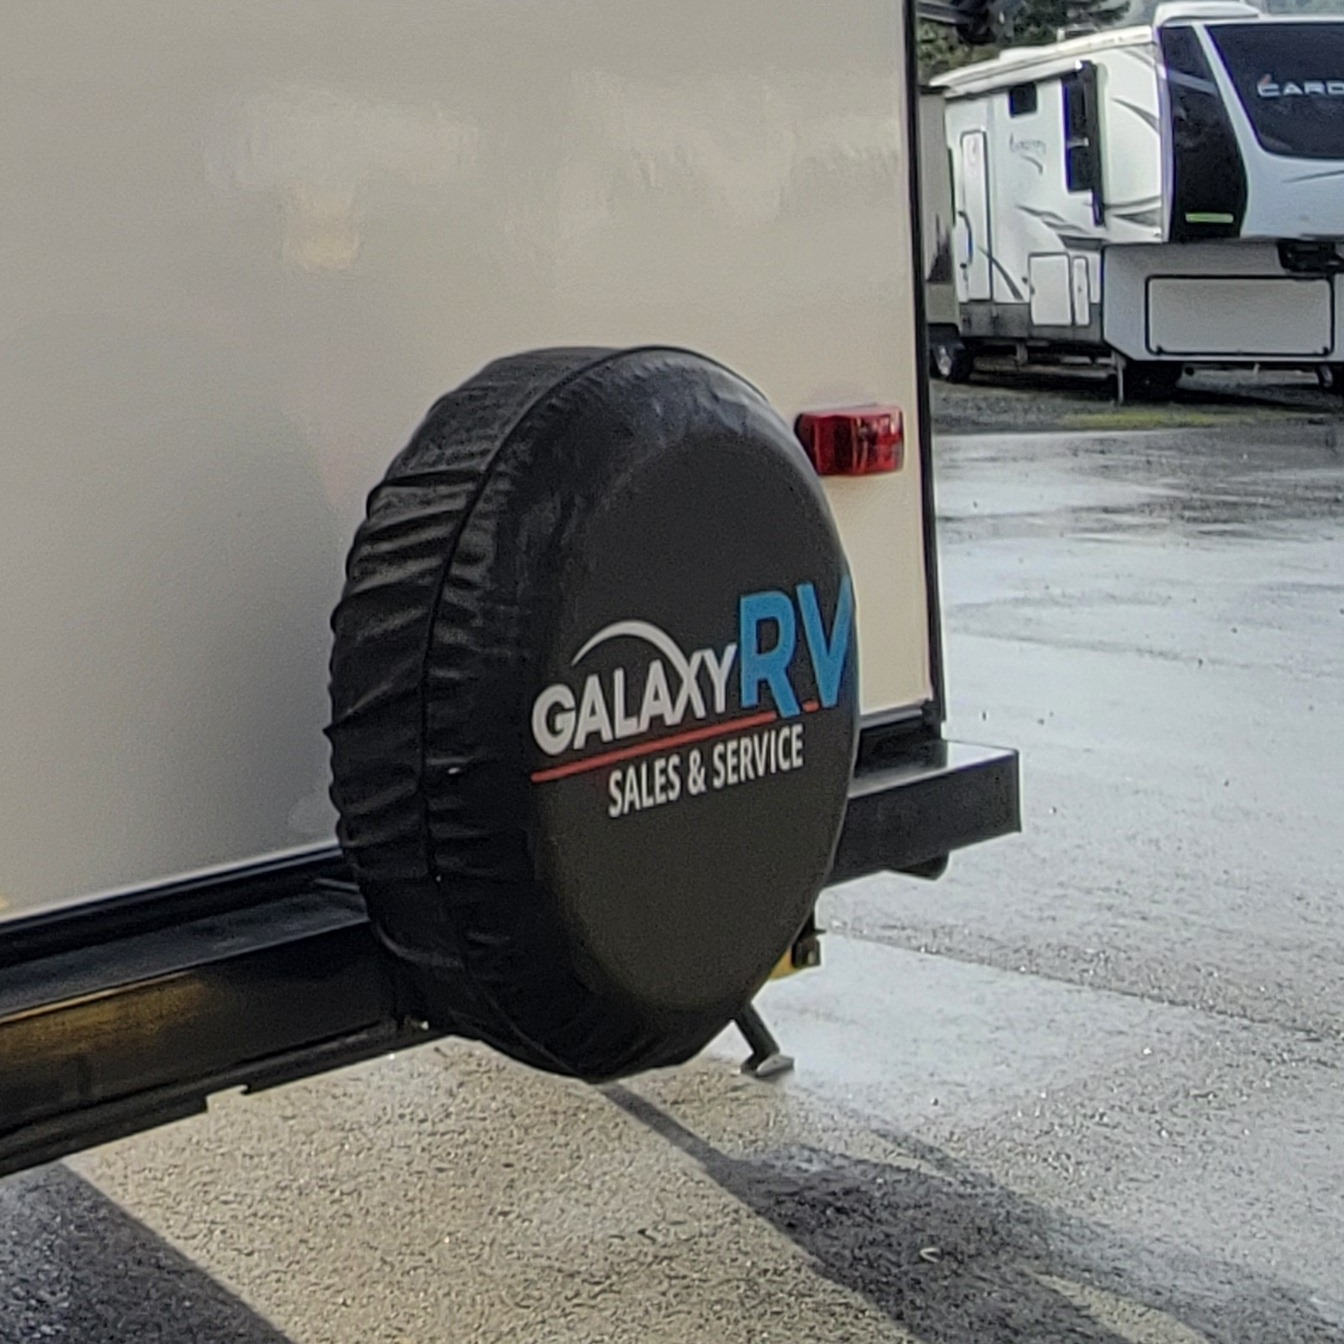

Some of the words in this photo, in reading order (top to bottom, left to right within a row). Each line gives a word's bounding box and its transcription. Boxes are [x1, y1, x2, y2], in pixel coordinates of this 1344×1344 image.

[1257, 75, 1344, 97] CARD
[531, 624, 737, 756] GALAXY
[739, 577, 853, 718] RV
[608, 754, 681, 818] SALES
[686, 749, 706, 795] &
[712, 723, 804, 790] SERVICE
